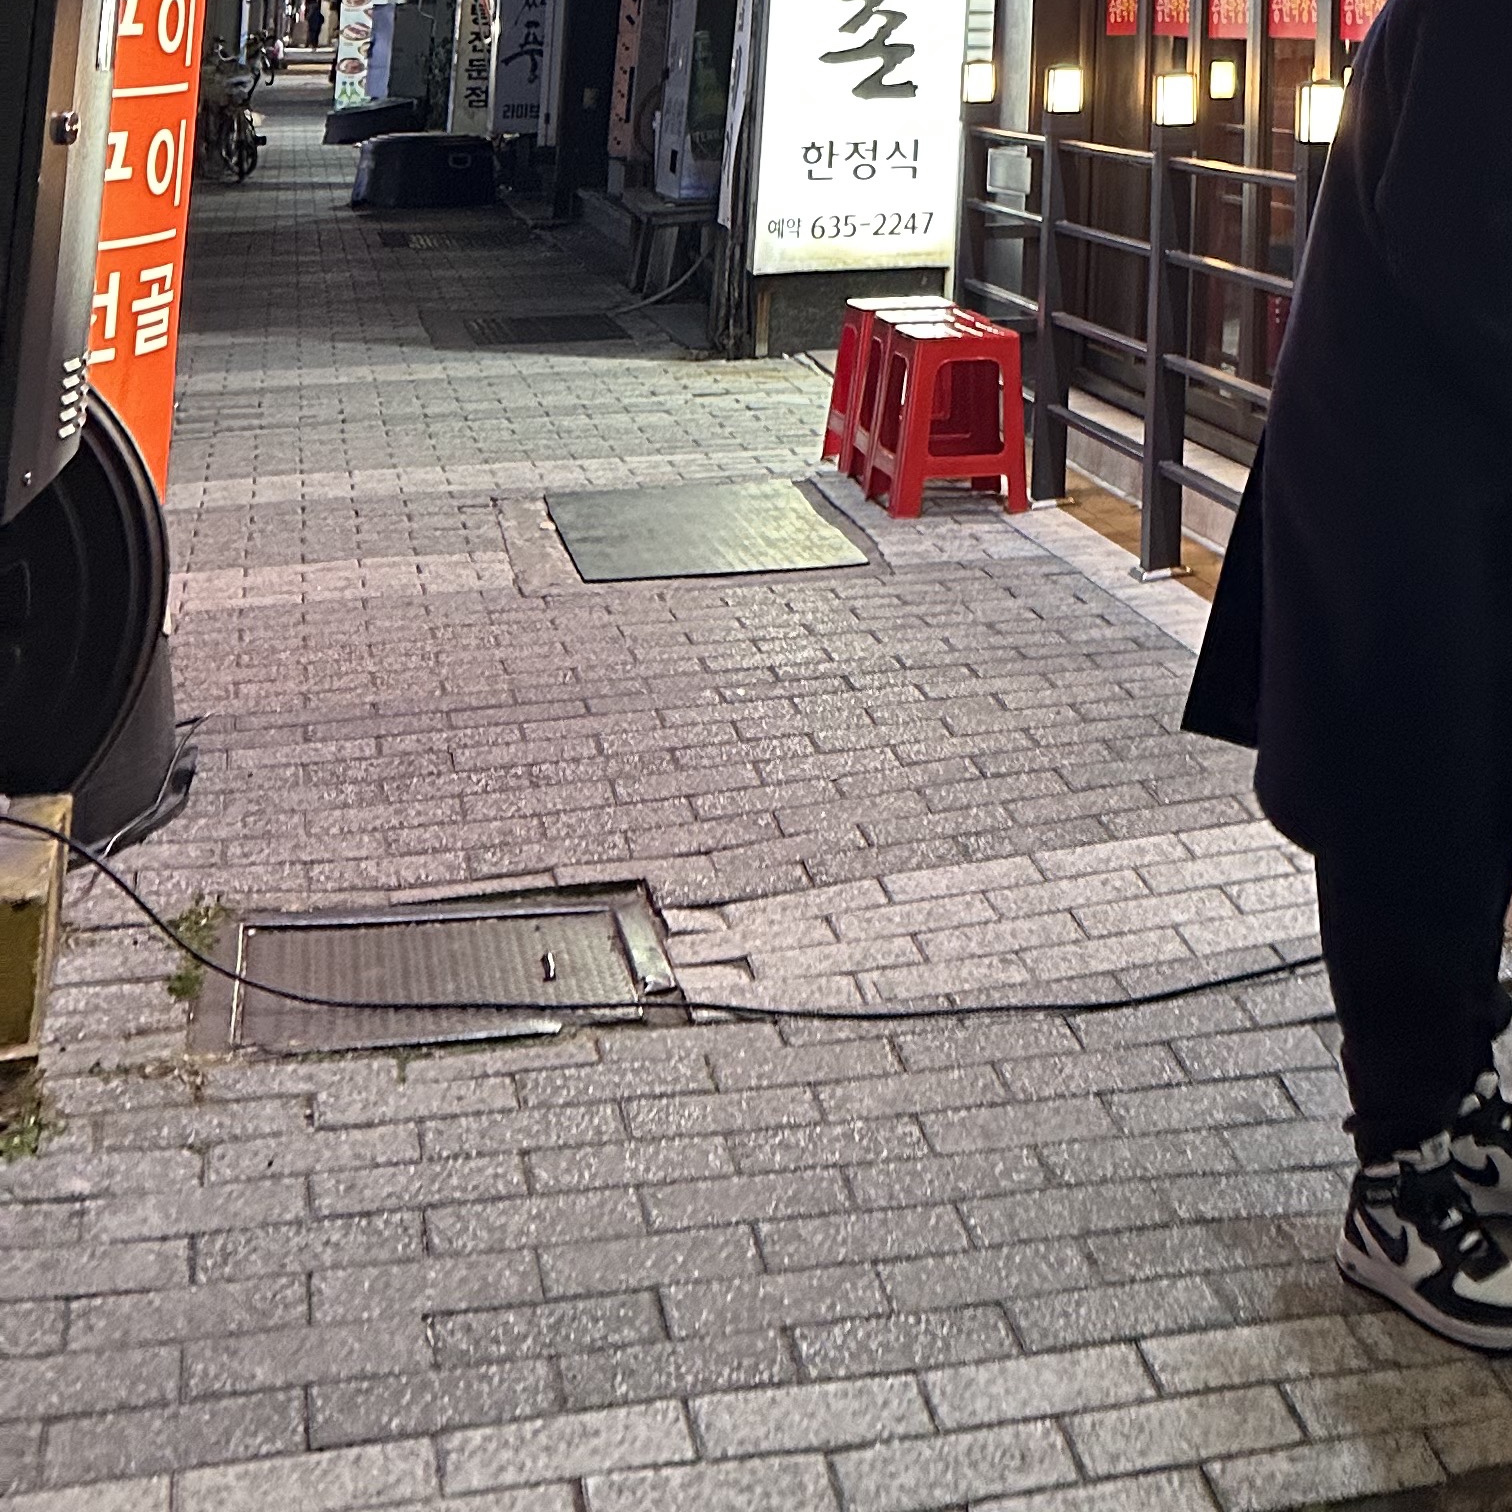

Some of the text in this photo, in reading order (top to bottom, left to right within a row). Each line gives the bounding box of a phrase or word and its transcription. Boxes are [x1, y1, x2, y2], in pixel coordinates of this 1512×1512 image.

[802, 140, 920, 181] 한정식
[767, 211, 934, 240] 예약 635-2247
